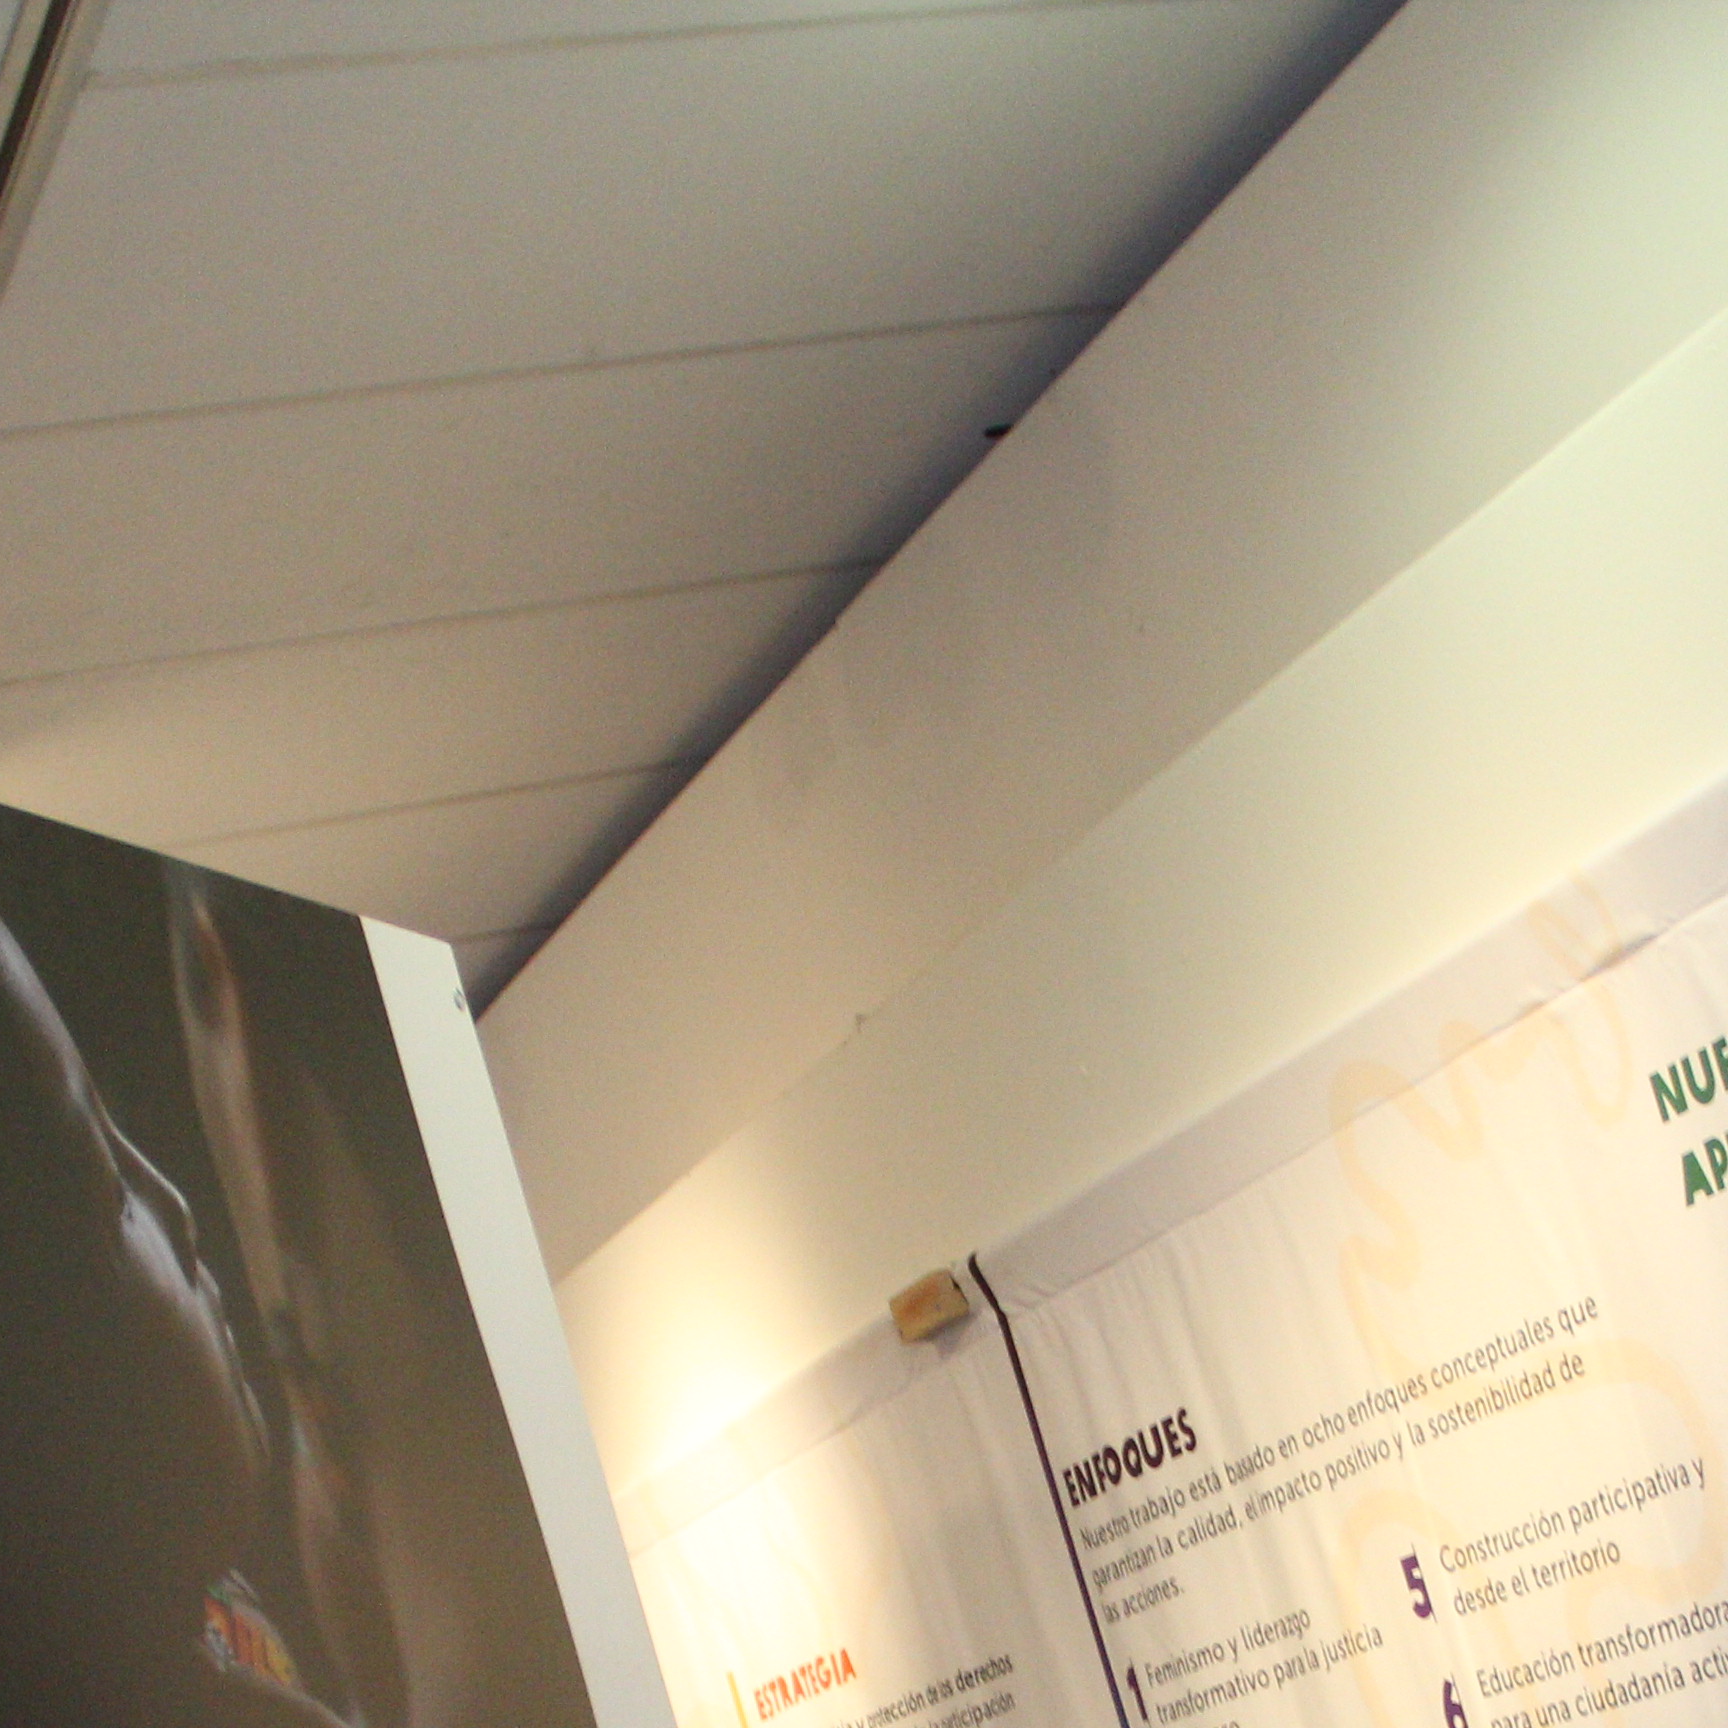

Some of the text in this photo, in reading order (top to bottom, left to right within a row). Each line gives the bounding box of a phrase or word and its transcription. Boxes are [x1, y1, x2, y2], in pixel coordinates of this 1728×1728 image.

[1063, 1409, 1197, 1507] ENFOQUES
[1080, 1297, 1598, 1549] Nuestro trabajo está basado ocho enfoques conceptuales que
[1092, 1354, 1585, 1595] garantizan calidad, impacto positivo sostenibilidad de
[1439, 1464, 1691, 1573] Construcción participativa
[1401, 1554, 1433, 1618] 5
[1454, 1542, 1620, 1616] desde territorio
[755, 1649, 856, 1720] ESTRATEGIA
[1145, 1609, 1310, 1686] Feminismo liderazgo
[1156, 1627, 1383, 1724] transformativo justicia
[1476, 1650, 1575, 1698] Educación
[1127, 1666, 1148, 1721] 1
[1536, 1701, 1571, 1728] una
[1575, 1664, 1686, 1717] ciudadanía
